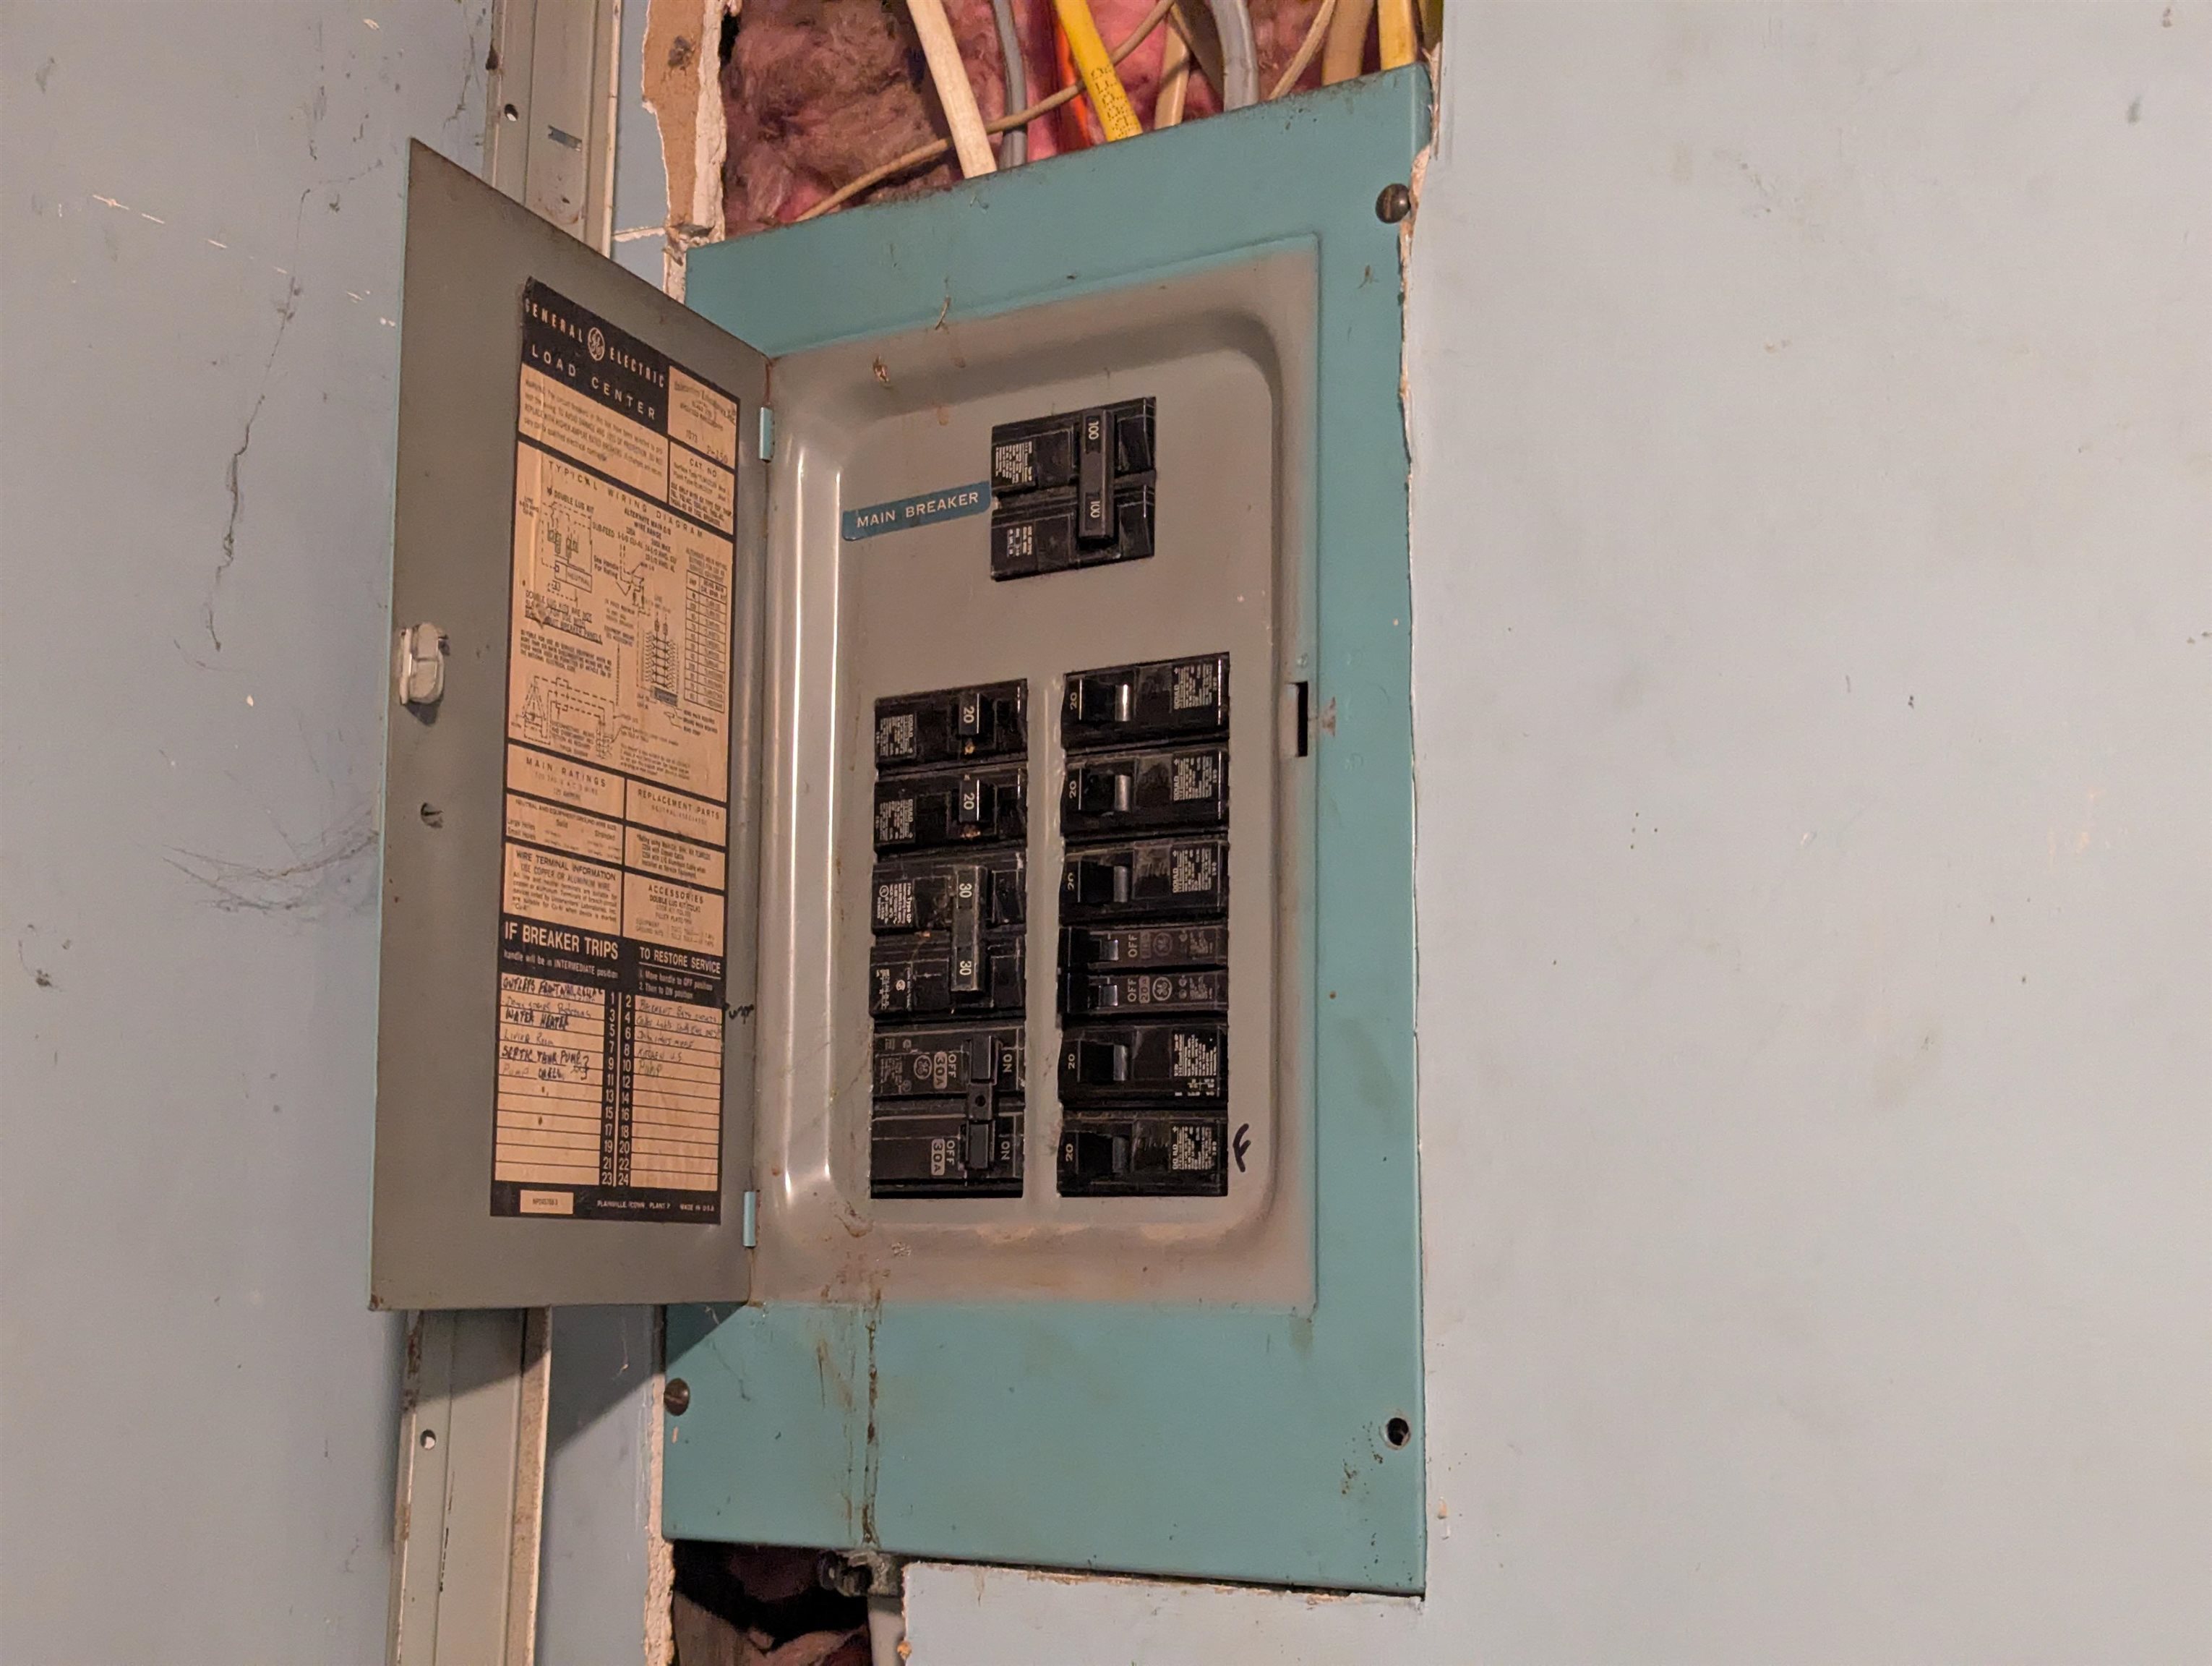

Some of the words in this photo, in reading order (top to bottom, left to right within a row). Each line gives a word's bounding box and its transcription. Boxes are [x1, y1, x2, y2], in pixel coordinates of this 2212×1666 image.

[525, 298, 582, 343] GENERAL
[610, 347, 665, 388] ELECTRIC
[532, 343, 576, 377] LOAD
[591, 376, 655, 420] CENTER
[1089, 421, 1099, 440] 100
[548, 459, 598, 491] TYPICAL
[607, 487, 647, 513] WIRING
[656, 510, 703, 539] DIAGRAM
[856, 509, 895, 528] MAIN
[906, 491, 979, 518] BREAKER
[1091, 500, 1100, 518] 100
[1070, 692, 1077, 710] 20
[963, 706, 974, 724] 20
[526, 756, 552, 771] MAIN
[561, 766, 606, 787] RATINGS
[1069, 781, 1076, 799] 20
[637, 787, 692, 811] REPLACEMENT
[696, 806, 719, 820] PARTS
[963, 793, 974, 810] 20
[516, 850, 531, 860] WIRE
[536, 855, 568, 871] TERMINAL
[572, 863, 615, 881] INFORMATION
[648, 883, 703, 904] ACCESSORIES
[959, 883, 972, 899] 30
[504, 920, 518, 941] IF
[521, 923, 580, 953] BREAKER
[583, 936, 619, 960] TRIPS
[1128, 934, 1137, 958] OFF
[553, 958, 595, 975] INTERMEDIATE
[638, 946, 651, 960] TO
[653, 949, 688, 967] RESTORE
[691, 957, 721, 974] SERVICE
[959, 960, 972, 975] 30
[610, 991, 614, 1005] 1
[1128, 978, 1136, 1003] OFF
[625, 995, 632, 1008] 2
[609, 1009, 614, 1020] 3
[625, 1011, 630, 1023] 4
[609, 1025, 614, 1037] 5
[625, 1027, 631, 1040] 6
[609, 1041, 614, 1054] 7
[624, 1043, 630, 1056] 8
[608, 1058, 614, 1070] 9
[623, 1059, 631, 1072] 10
[1003, 1054, 1012, 1073] ON
[1068, 1053, 1076, 1069] 20
[935, 1057, 946, 1086] 30A
[607, 1074, 614, 1086] 11
[622, 1076, 631, 1088] 12
[606, 1090, 614, 1103] 13
[622, 1092, 630, 1105] 14
[605, 1106, 614, 1119] 15
[621, 1108, 630, 1121] 16
[604, 1123, 613, 1135] 17
[621, 1126, 630, 1138] 18
[604, 1139, 613, 1151] 19
[620, 1142, 630, 1153] 20
[1000, 1141, 1010, 1161] ON
[1066, 1143, 1073, 1163] 20
[1233, 1123, 1251, 1173] F
[603, 1156, 612, 1169] 21
[933, 1141, 943, 1172] 30A
[619, 1159, 630, 1171] 22
[602, 1172, 613, 1185] 23
[618, 1174, 630, 1185] 24
